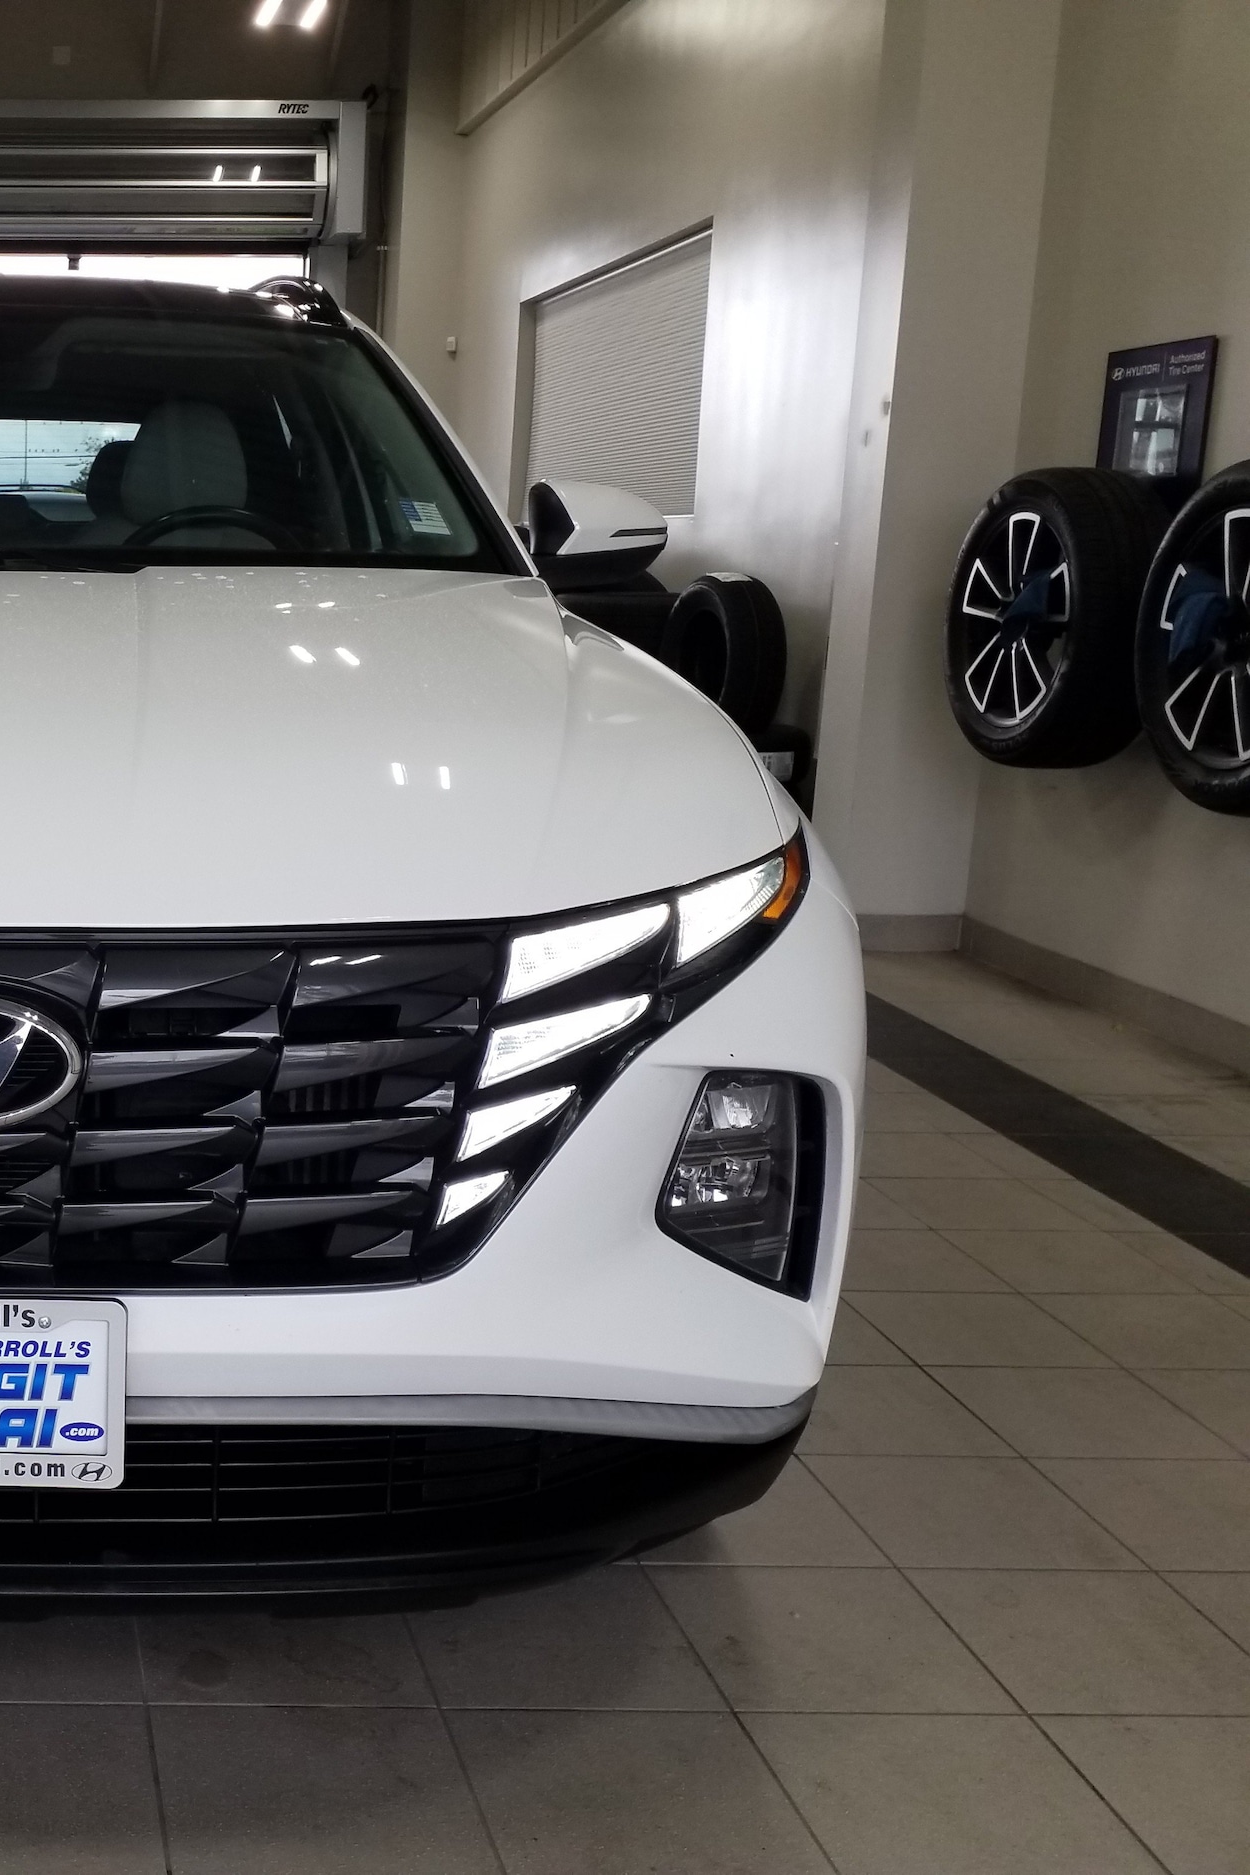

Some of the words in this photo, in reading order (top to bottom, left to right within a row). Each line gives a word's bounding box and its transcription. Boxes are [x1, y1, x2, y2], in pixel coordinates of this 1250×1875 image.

[278, 103, 309, 114] RYTEC
[1170, 351, 1206, 364] Authorized
[1126, 364, 1160, 377] HYUNDAI
[1168, 365, 1180, 376] Tire
[1182, 364, 1205, 375] Center
